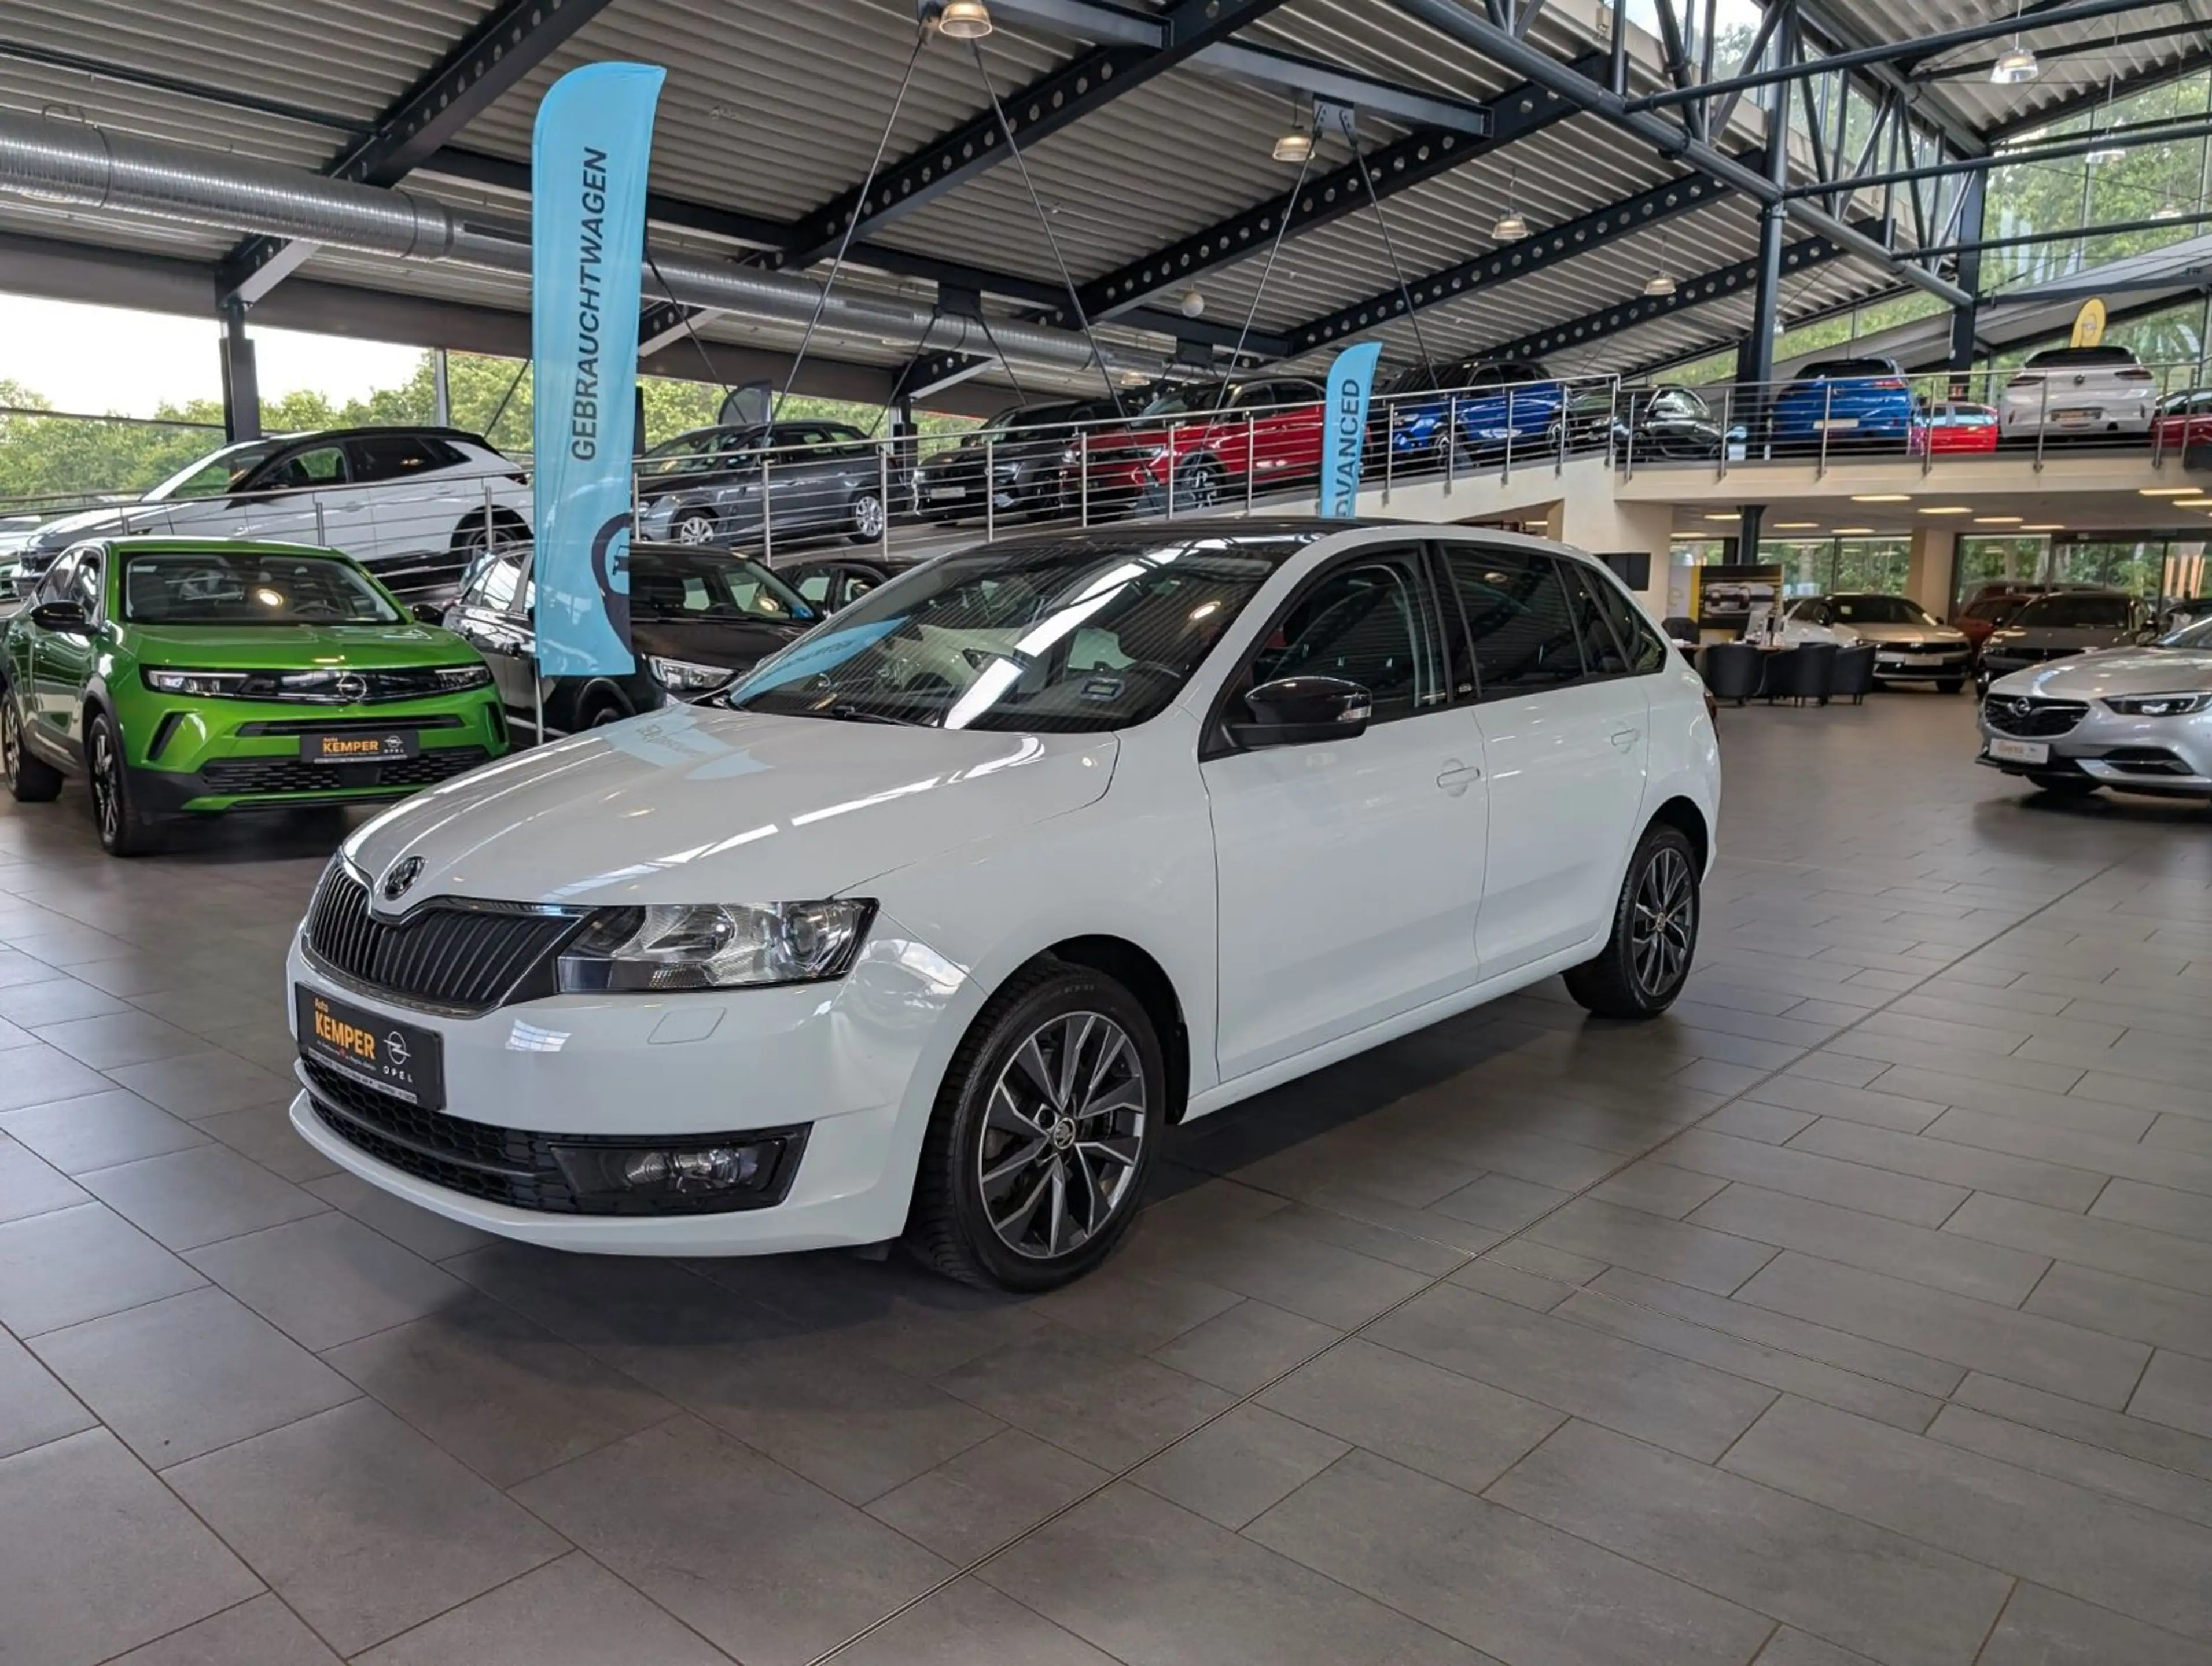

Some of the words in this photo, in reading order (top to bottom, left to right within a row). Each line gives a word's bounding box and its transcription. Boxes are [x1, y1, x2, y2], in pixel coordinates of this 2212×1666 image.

[572, 148, 608, 462] GEBRAUCHTWAGEN
[323, 740, 379, 753] KEMPER
[315, 1011, 376, 1060] KEMPER
[382, 1065, 413, 1083] OPEL
